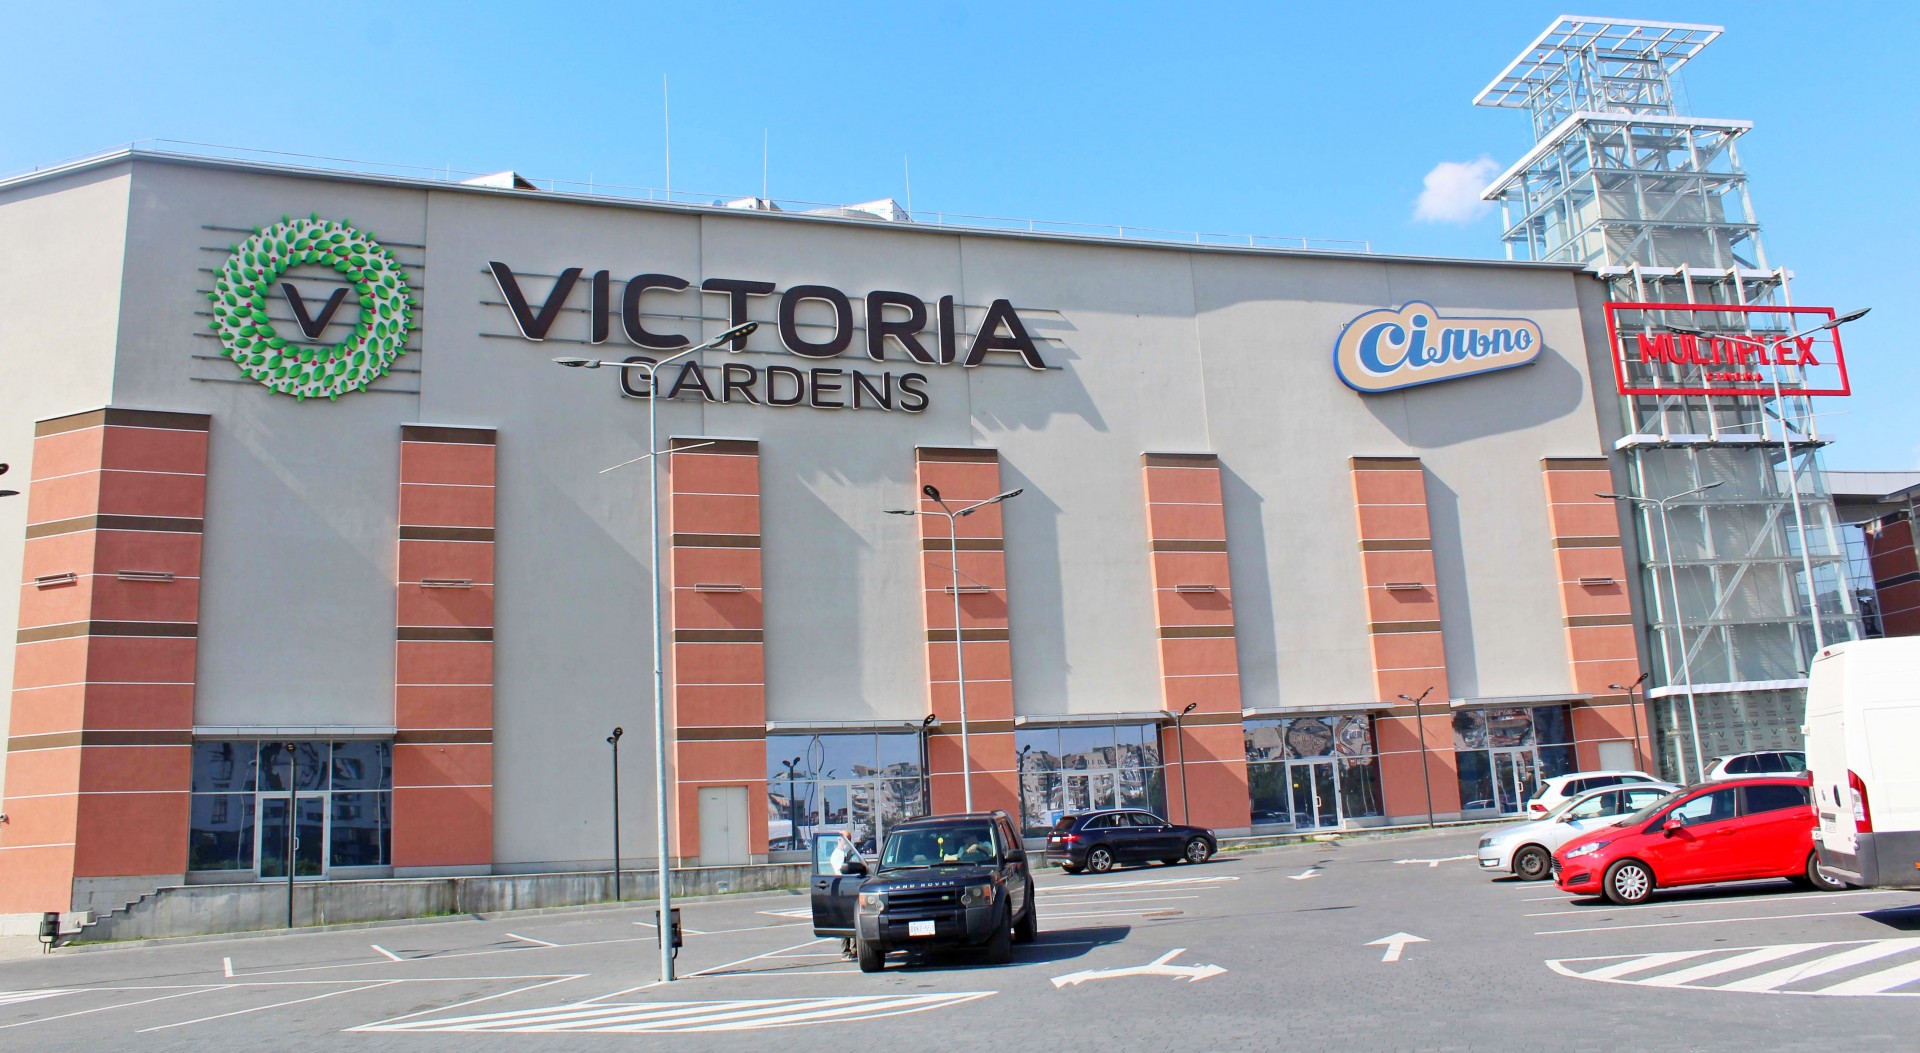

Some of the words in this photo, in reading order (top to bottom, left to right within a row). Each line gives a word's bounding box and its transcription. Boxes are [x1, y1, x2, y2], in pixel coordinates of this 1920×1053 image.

[281, 282, 349, 341] V
[487, 260, 1047, 371] VICTORIA
[1356, 313, 1534, 377] Сільпо
[1636, 332, 1820, 366] MULTIPLEX
[619, 356, 930, 413] GARDENS
